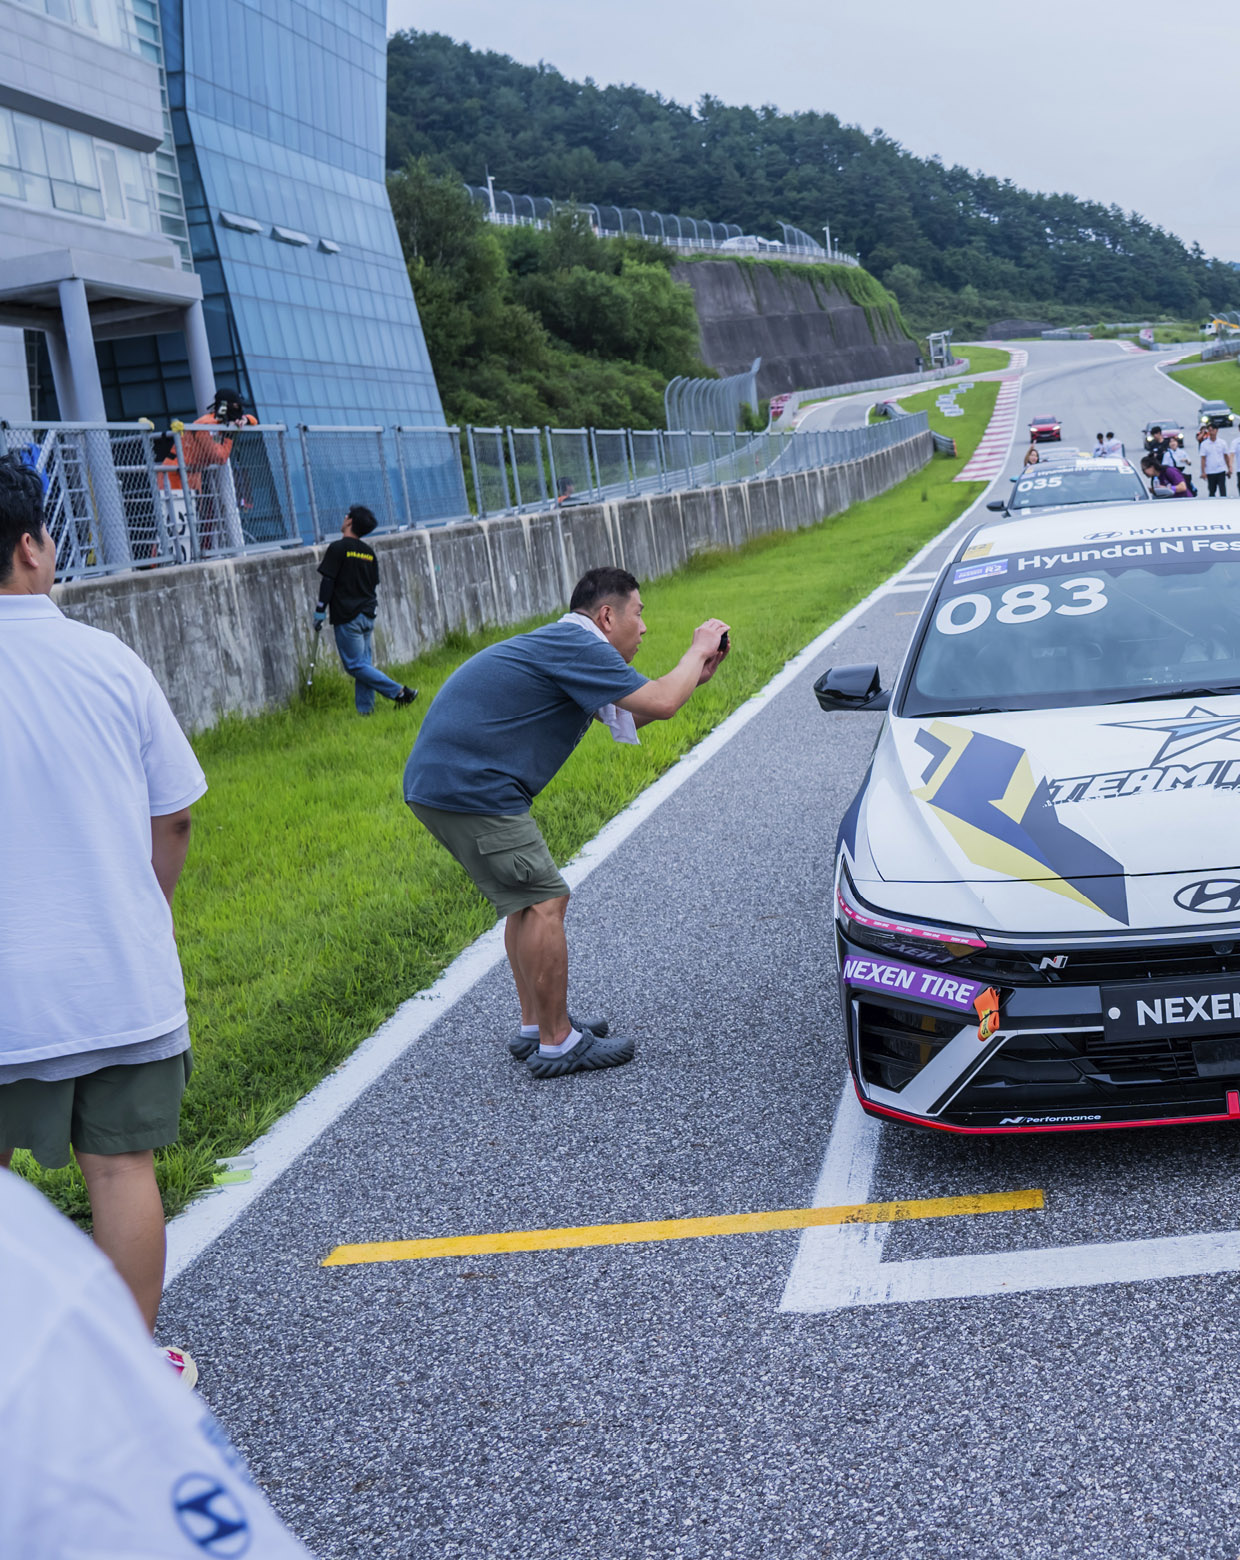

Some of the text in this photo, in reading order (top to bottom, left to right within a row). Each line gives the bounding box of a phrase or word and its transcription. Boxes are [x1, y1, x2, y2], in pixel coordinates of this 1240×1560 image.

[1017, 476, 1062, 492] 035
[1129, 524, 1232, 536] HYUNDAI
[1017, 541, 1152, 571] Hyundai
[1160, 540, 1185, 554] N
[935, 577, 1109, 635] 083
[1049, 762, 1216, 801] TEAM
[843, 959, 975, 1004] NEXEN TIRE
[1026, 1114, 1102, 1123] Performance
